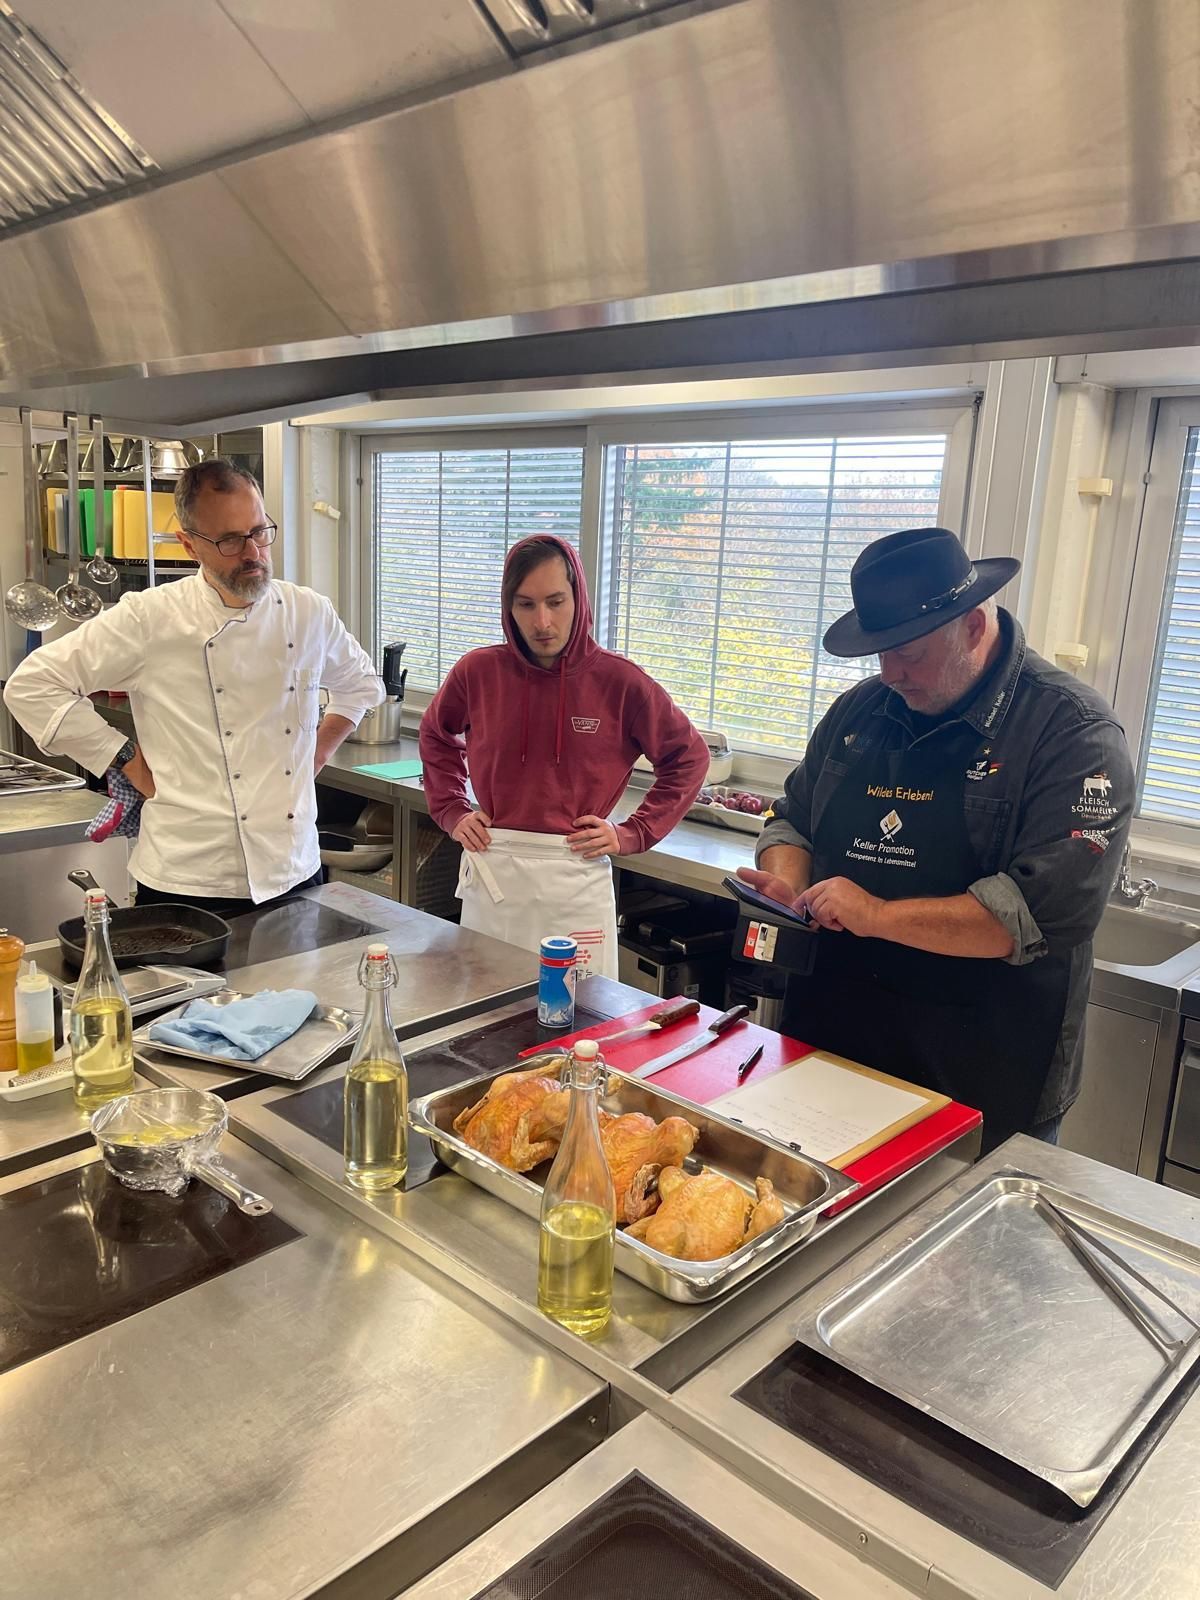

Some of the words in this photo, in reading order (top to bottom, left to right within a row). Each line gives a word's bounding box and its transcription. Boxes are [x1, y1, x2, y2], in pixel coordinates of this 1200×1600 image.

[867, 785, 893, 798] Wildes
[896, 786, 934, 801] Erleben!
[1071, 805, 1118, 815] SOMMELIER
[1079, 797, 1109, 807] FLEISCH
[853, 837, 877, 851] Keller
[878, 843, 915, 856] Promotion
[845, 850, 877, 863] Kompetenz
[884, 858, 917, 868] Lebensmittel
